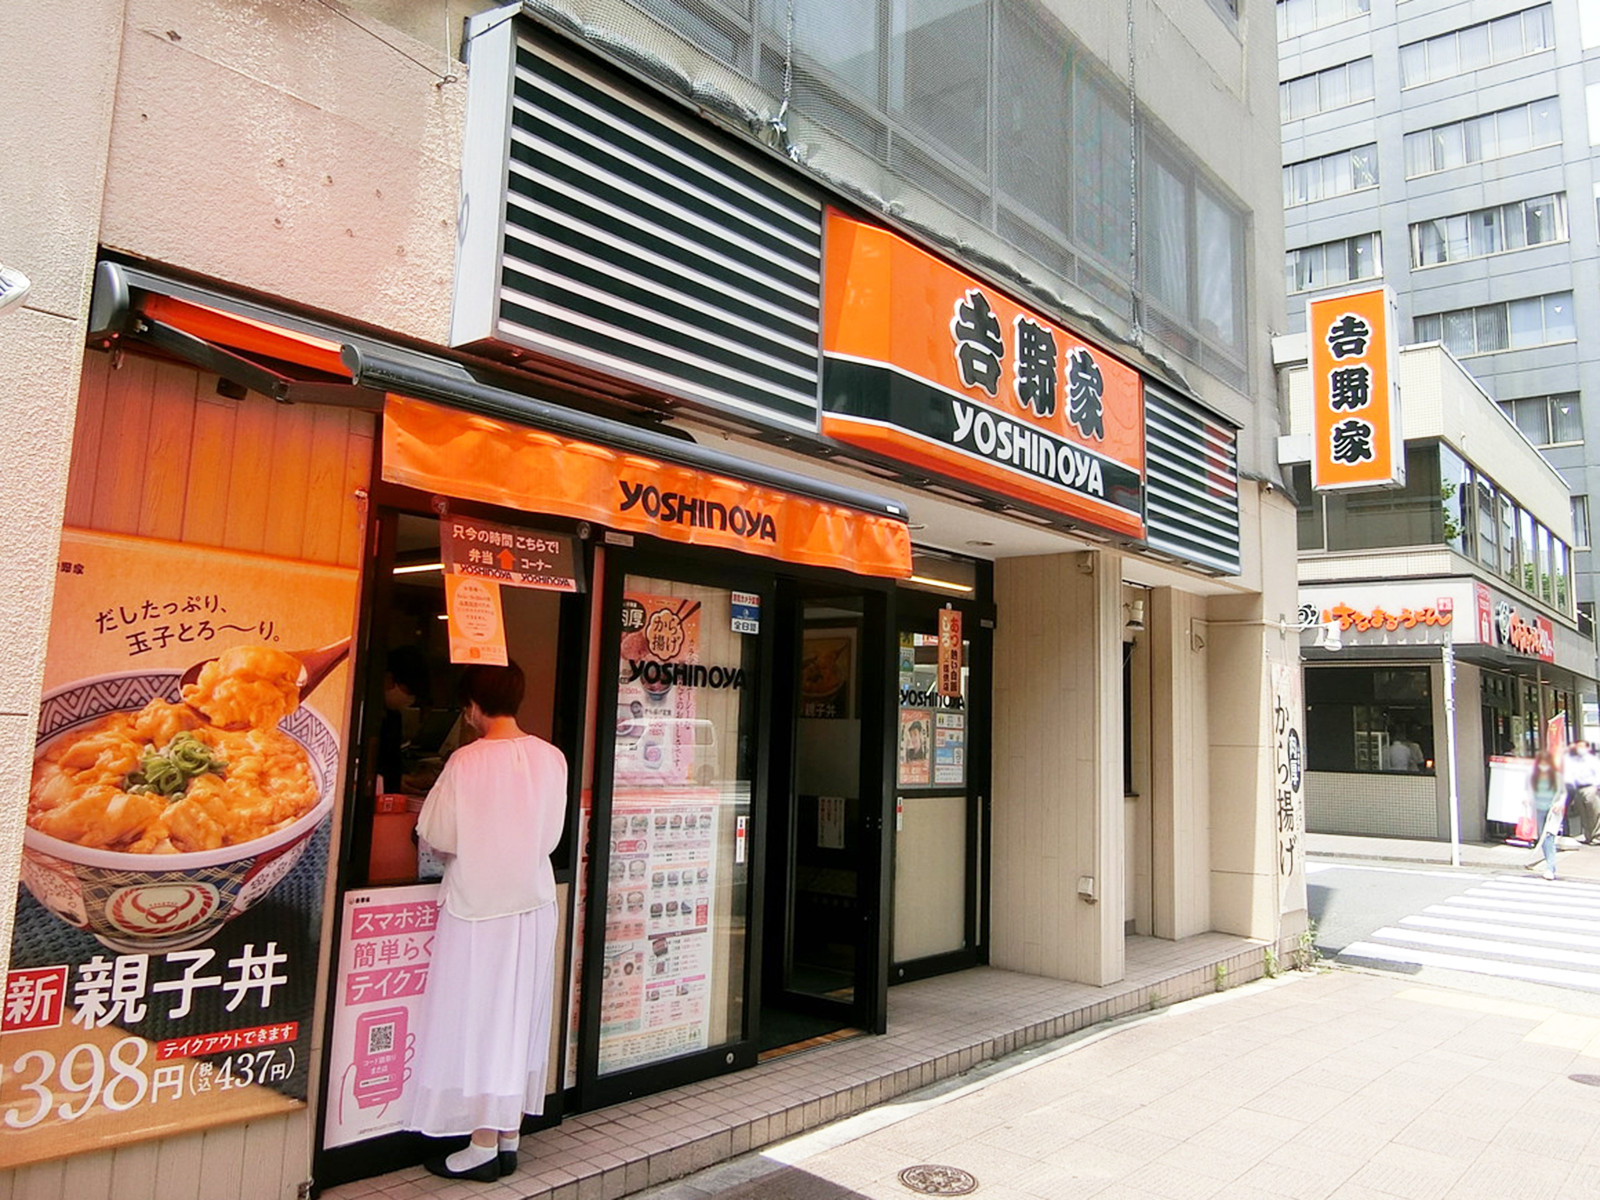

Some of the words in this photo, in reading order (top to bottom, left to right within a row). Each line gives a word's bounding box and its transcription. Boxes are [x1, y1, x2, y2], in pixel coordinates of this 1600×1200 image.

[952, 400, 1105, 497] YOSHINOYA
[618, 480, 777, 543] YOSHINOYA
[452, 524, 513, 548] 只今の時間
[57, 561, 84, 575] 野家
[460, 563, 513, 581] YOSHINOYA
[468, 548, 494, 565] 弁当
[521, 558, 552, 571] コーナー
[520, 573, 572, 588] YOSHINOYA
[95, 594, 228, 634] だしたっぷり、
[654, 615, 679, 635] から
[628, 659, 749, 690] YOSHINOYA
[355, 905, 440, 934] スマホ注
[353, 935, 435, 970] 簡単らく
[5, 973, 58, 1024] 新
[71, 942, 289, 1030] 親子丼
[163, 1024, 294, 1058] テイクアウトできます
